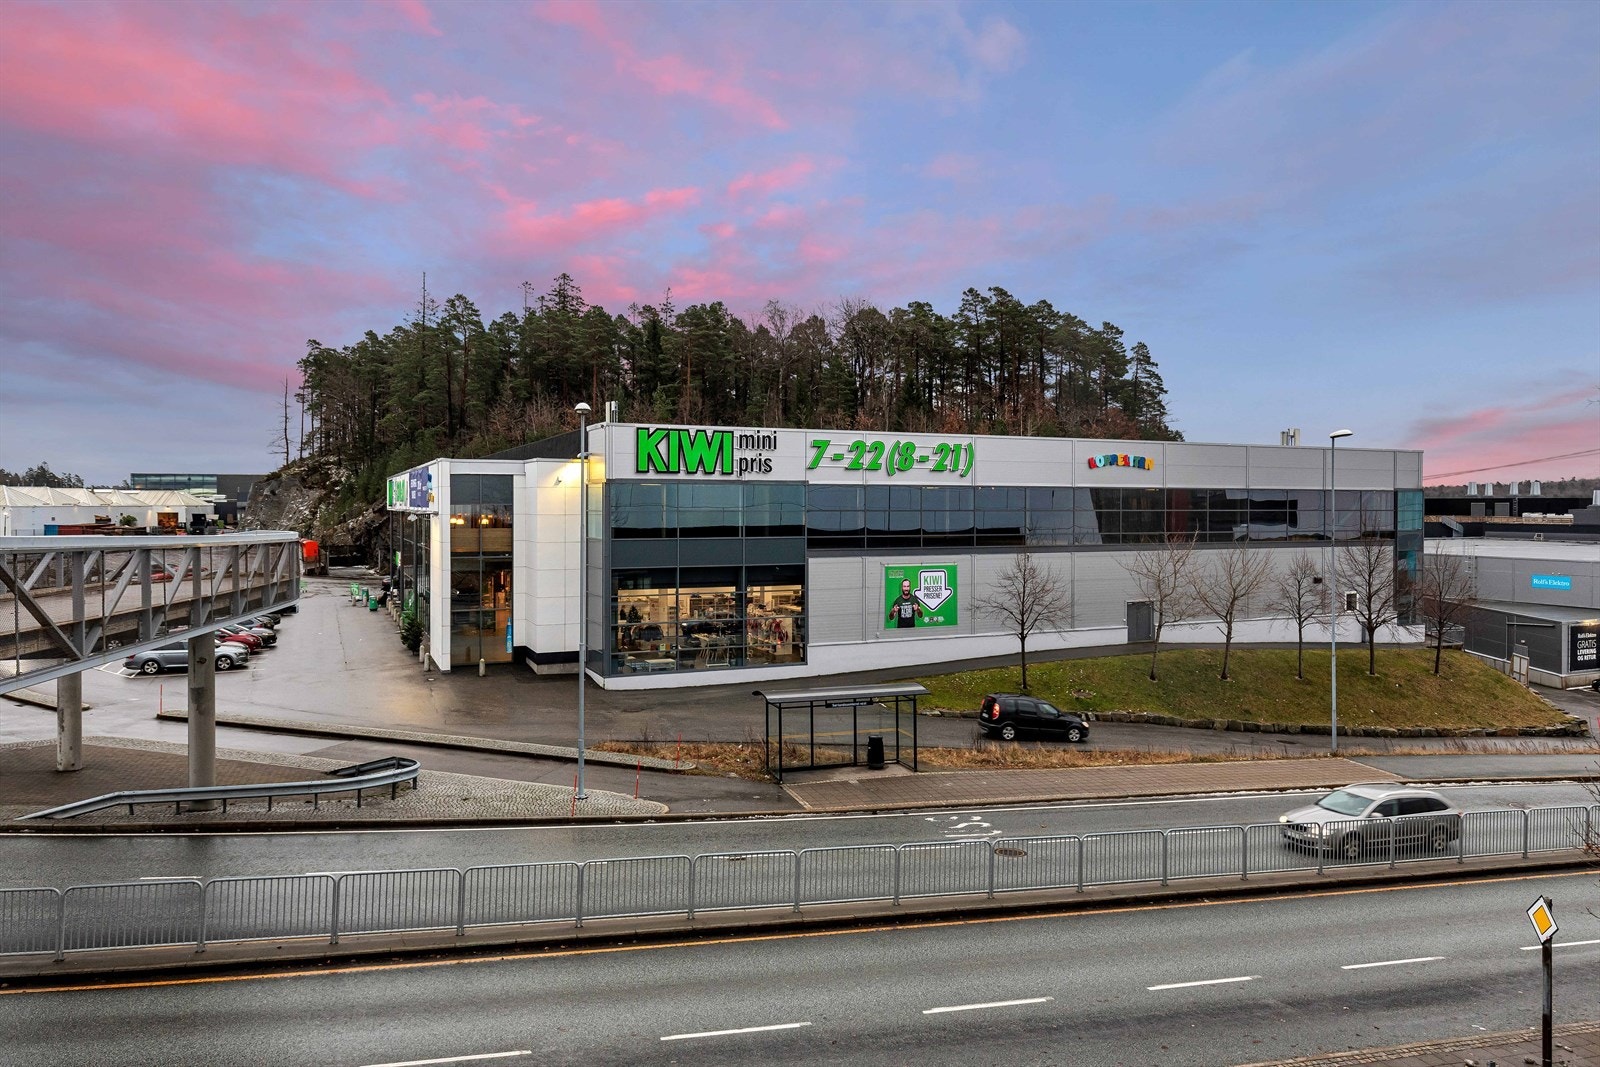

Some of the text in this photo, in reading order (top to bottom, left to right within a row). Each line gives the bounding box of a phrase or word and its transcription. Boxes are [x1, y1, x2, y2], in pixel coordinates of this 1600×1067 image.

[739, 430, 777, 450] mini
[636, 427, 734, 474] KIWI
[739, 453, 773, 476] pris
[924, 576, 942, 585] KIWI
[1549, 579, 1570, 587] Elektro
[1577, 640, 1597, 649] GRATIS
[1577, 648, 1597, 656] LEVERING
